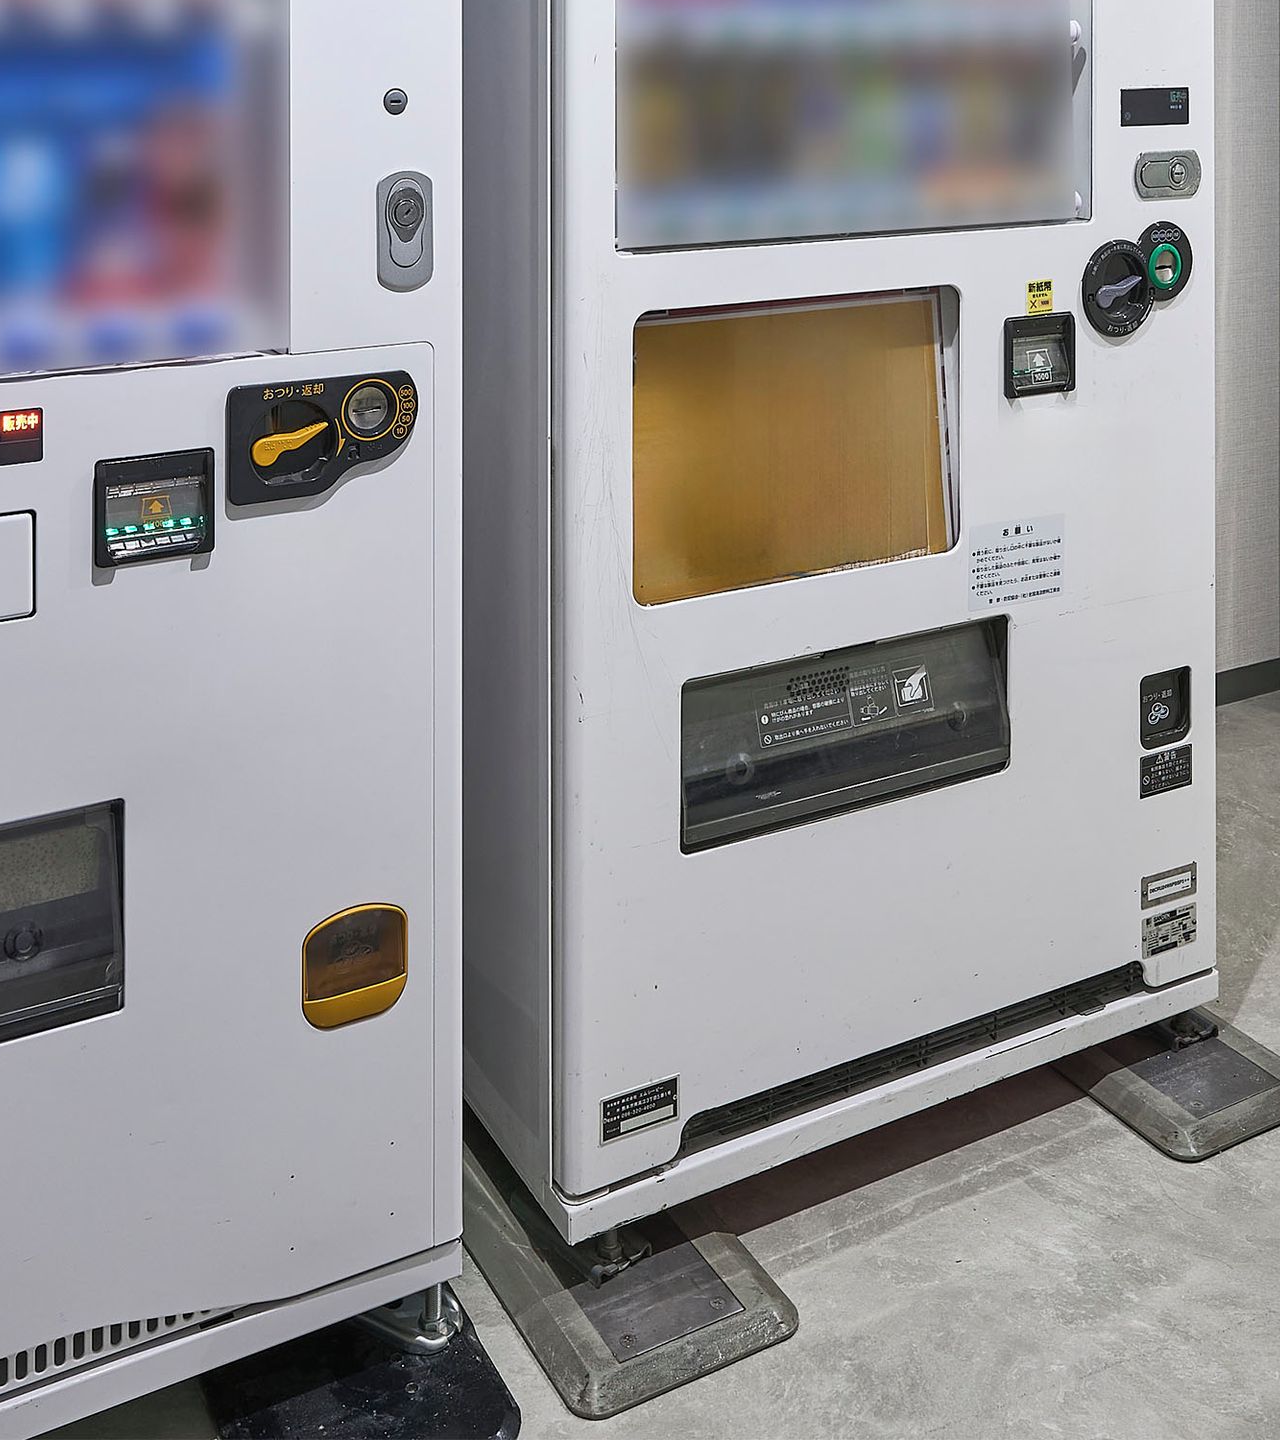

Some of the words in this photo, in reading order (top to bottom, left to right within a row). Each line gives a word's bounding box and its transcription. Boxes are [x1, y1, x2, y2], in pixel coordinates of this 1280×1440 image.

[263, 383, 324, 401] おつり・返却
[400, 389, 413, 397] 500
[2, 412, 39, 432] 販売中
[396, 427, 404, 435] 10
